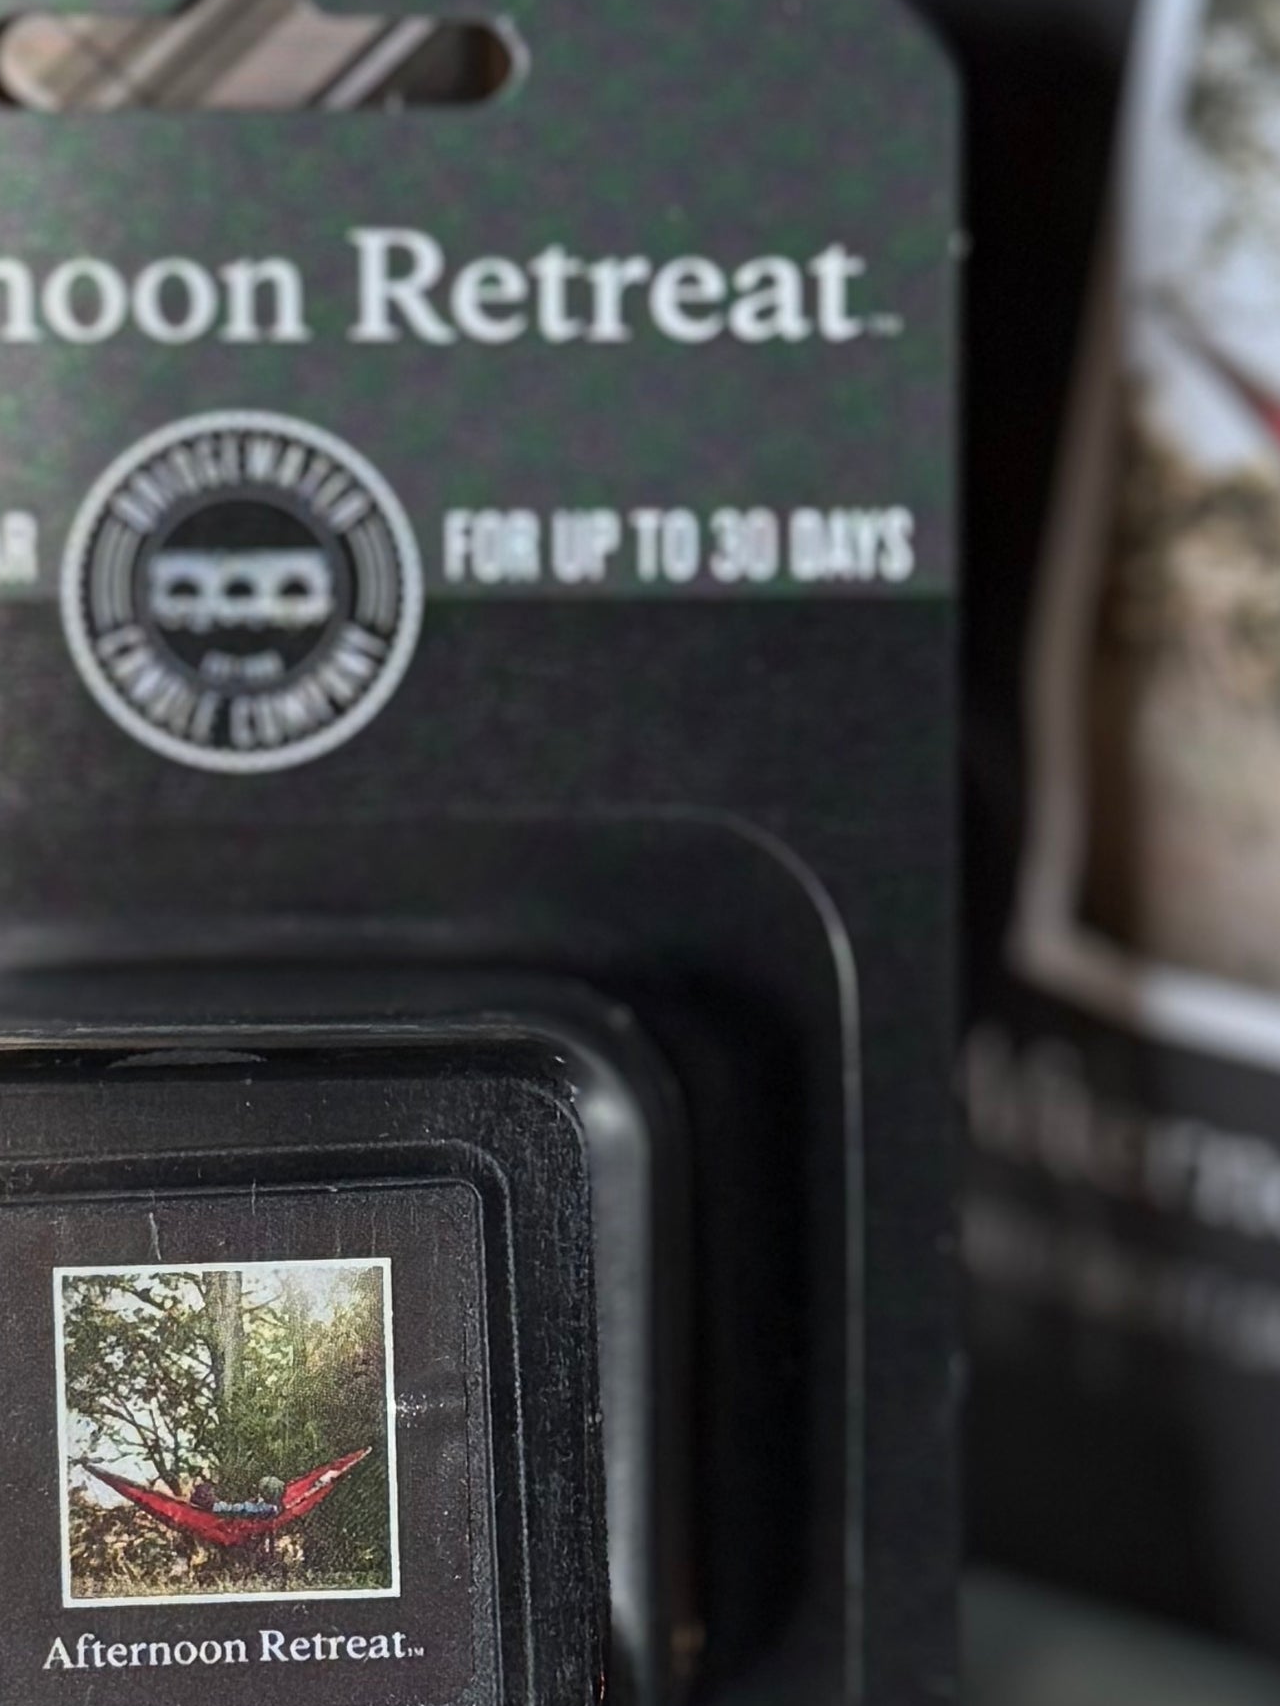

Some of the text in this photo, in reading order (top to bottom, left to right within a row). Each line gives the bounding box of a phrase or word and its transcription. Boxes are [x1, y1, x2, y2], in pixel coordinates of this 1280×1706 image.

[441, 505, 917, 584] FOR UP TO 30 DAYS
[41, 1632, 248, 1671] Afternoon
